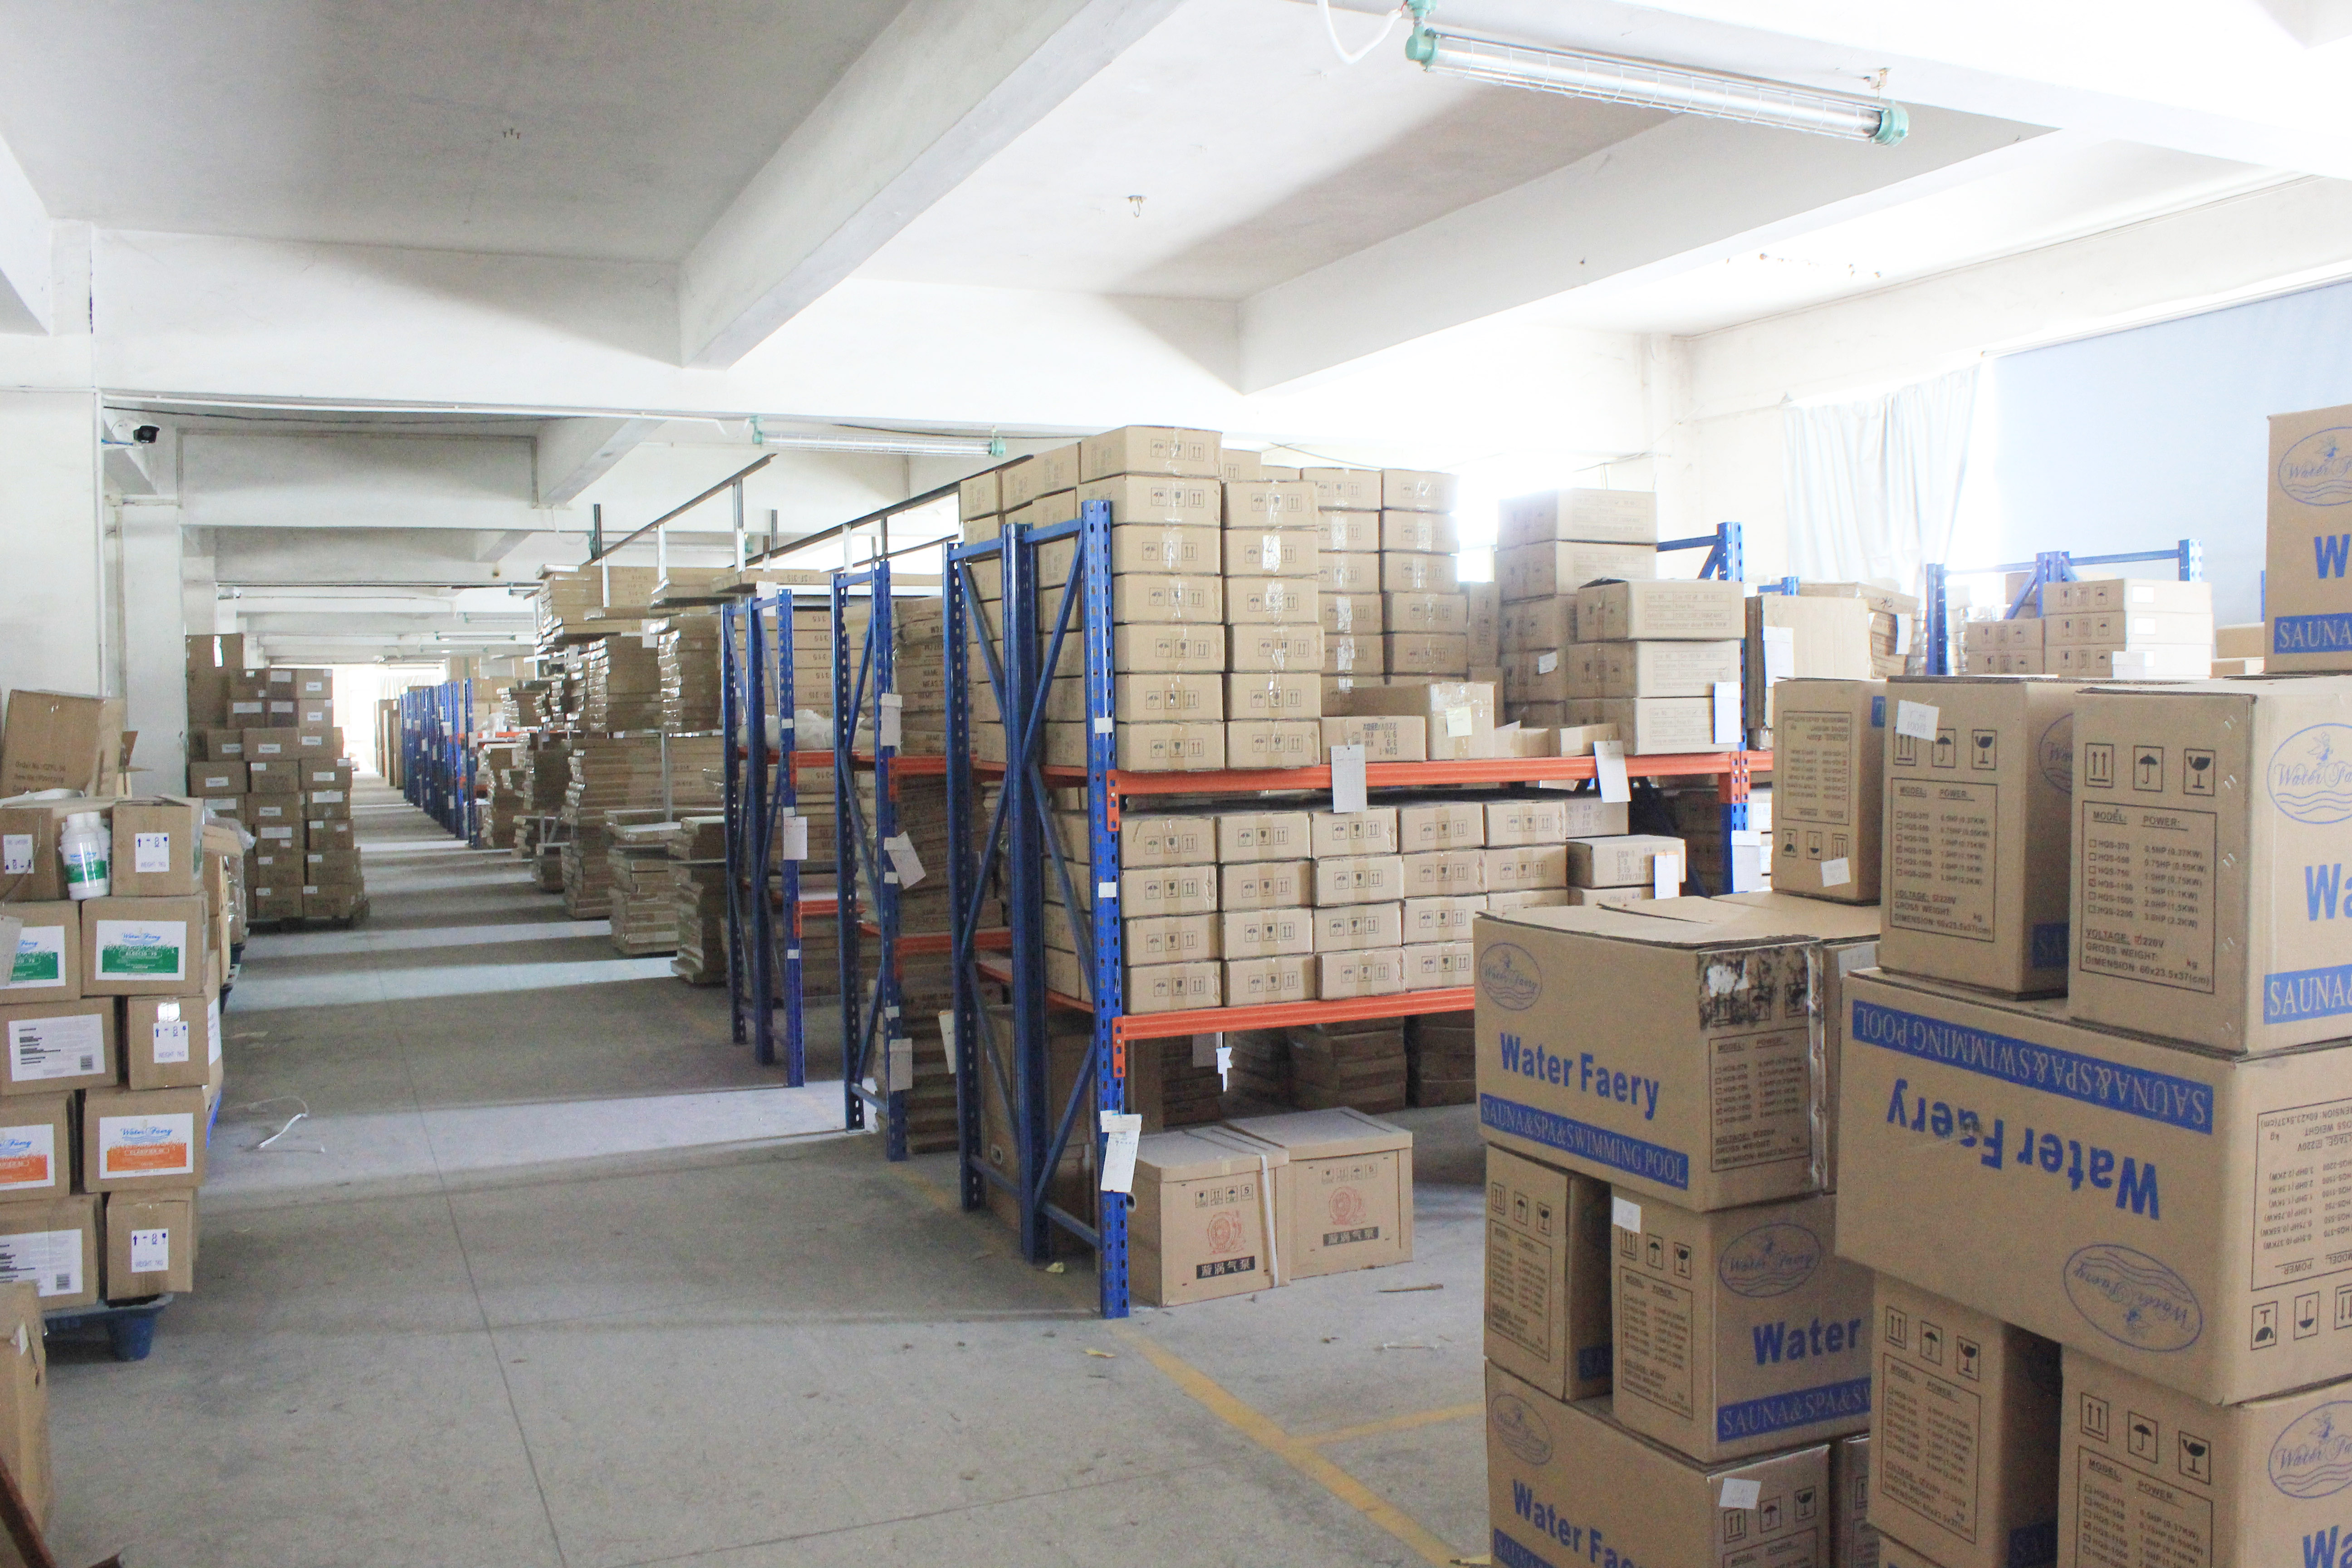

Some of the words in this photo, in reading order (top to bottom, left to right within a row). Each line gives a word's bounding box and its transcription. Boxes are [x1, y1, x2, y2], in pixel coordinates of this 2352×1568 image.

[2274, 764, 2323, 786] Water
[2086, 942, 2117, 955] GROSS
[2186, 958, 2197, 970] kg
[1857, 1006, 1906, 1043] POOL
[1500, 1032, 1571, 1088] Water
[1580, 1053, 1659, 1121] Faery
[1913, 1019, 2206, 1125] SAUNA&SPA&SWIMMING
[1482, 1098, 1642, 1171] SAUNA&SPA&SWIMMING
[1645, 1155, 1686, 1186] POOL
[1886, 1078, 2004, 1171] Faery
[2270, 1132, 2279, 1142] kg
[2298, 1141, 2315, 1152] 220V
[2016, 1127, 2160, 1221] Water
[1753, 1316, 1862, 1366] Water
[1513, 1479, 1582, 1553] Water
